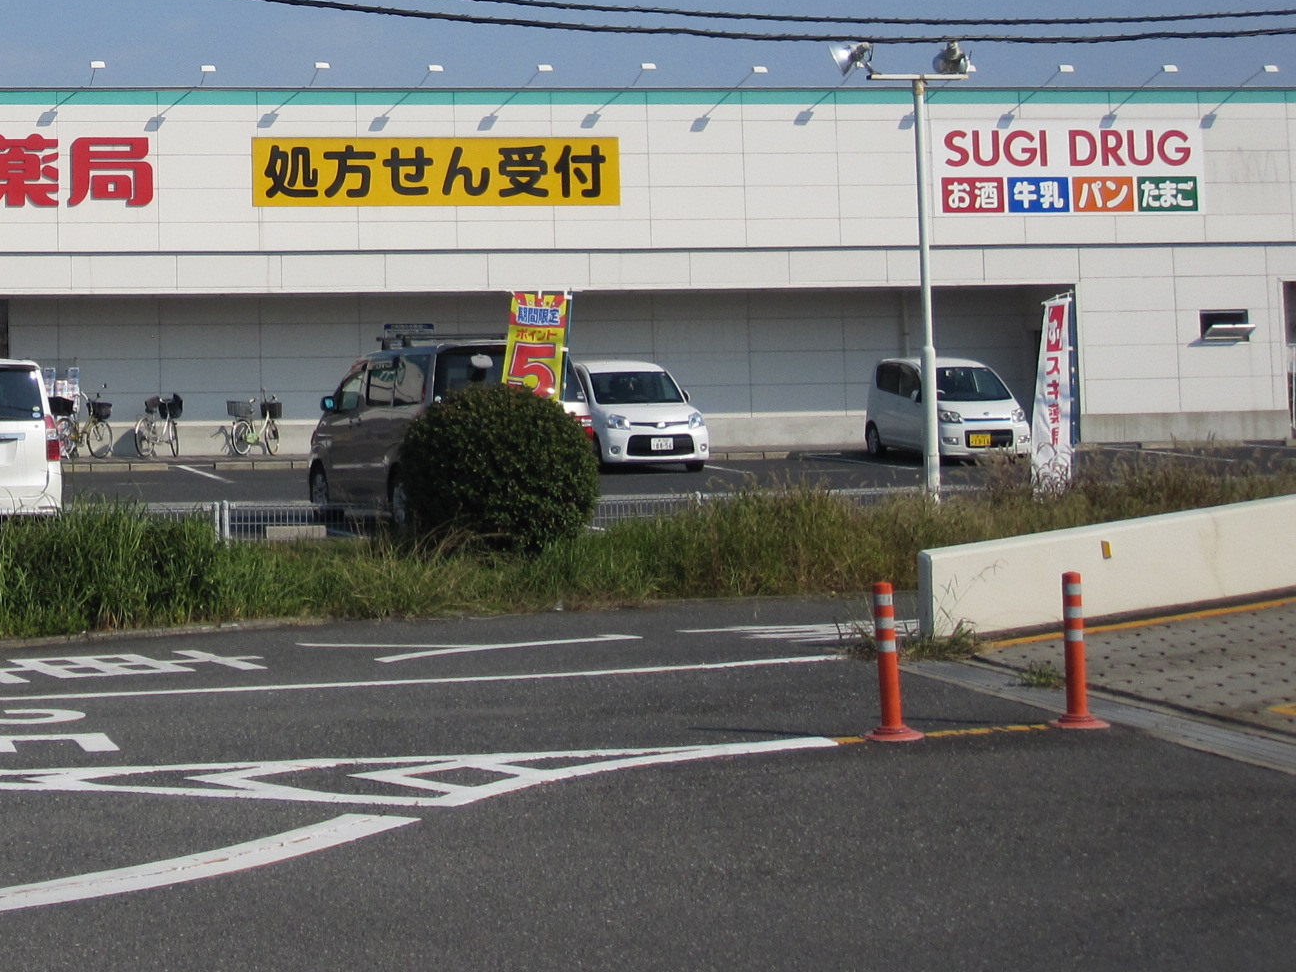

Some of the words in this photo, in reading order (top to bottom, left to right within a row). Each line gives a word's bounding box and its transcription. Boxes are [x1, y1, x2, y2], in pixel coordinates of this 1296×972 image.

[943, 129, 1048, 167] SUGI
[1068, 129, 1192, 167] DRUG
[264, 145, 607, 199] 処方せん受付
[946, 181, 999, 210] お酒
[1013, 181, 1064, 209] 牛乳
[1077, 181, 1129, 209] パン
[1140, 181, 1194, 208] たまご
[517, 305, 560, 325] 期間限定
[516, 329, 558, 341] ポイント
[507, 341, 556, 398] 5
